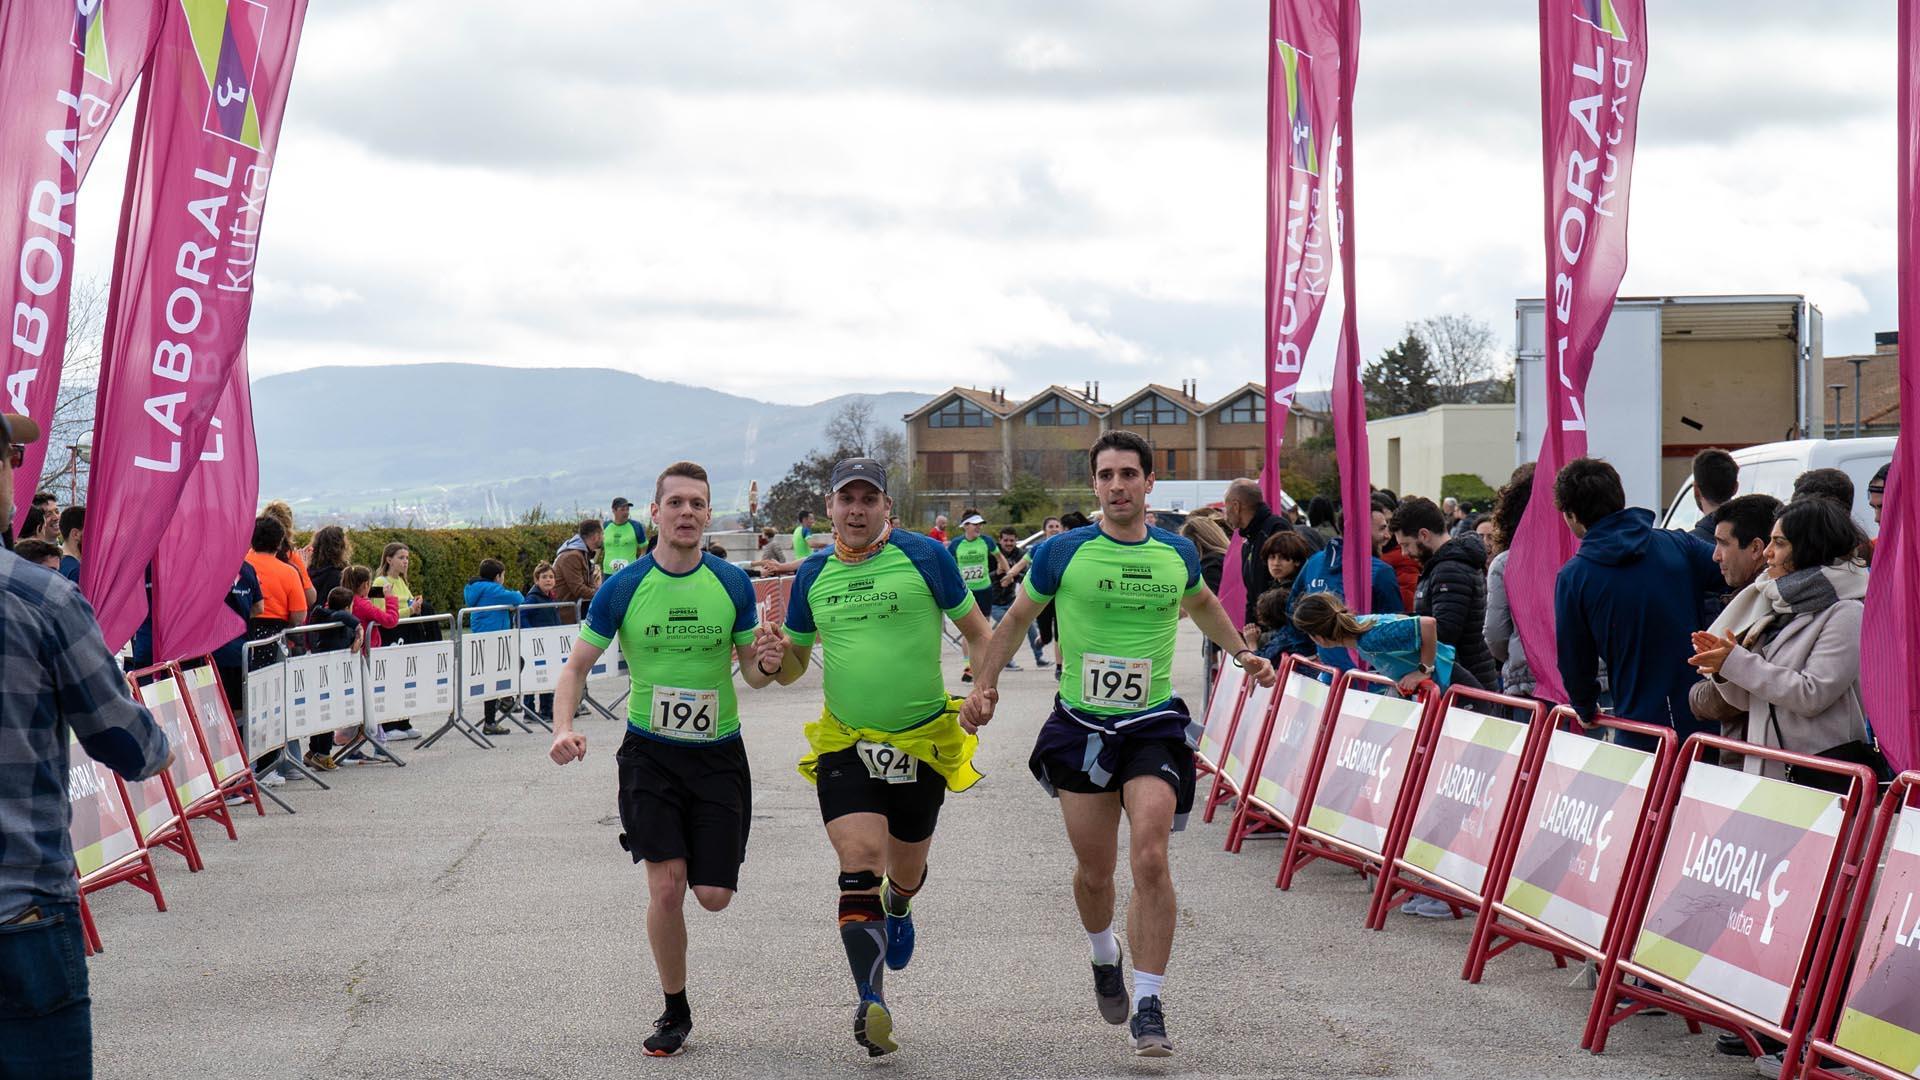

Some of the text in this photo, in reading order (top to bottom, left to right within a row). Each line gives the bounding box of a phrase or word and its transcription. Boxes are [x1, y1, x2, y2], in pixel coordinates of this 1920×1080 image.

[217, 163, 270, 292] kutxa
[134, 156, 237, 472] LABORAL
[964, 569, 984, 580] 222
[1119, 580, 1178, 593] tracasa
[843, 591, 898, 603] tracasa
[665, 624, 723, 635] tracasa
[470, 635, 512, 677] DN DN
[532, 638, 545, 657] DN
[294, 669, 305, 693] DN
[343, 661, 353, 684] DN
[375, 653, 448, 681] DN DN DN
[1090, 669, 1142, 701] 195
[660, 701, 711, 732] 196
[864, 749, 911, 776] 194
[1337, 736, 1381, 777] LABORAL
[1437, 761, 1487, 807] LABORAL
[1540, 791, 1599, 846] LABORAL
[1682, 831, 1767, 902] LABORAL
[1727, 906, 1754, 937] kutxa
